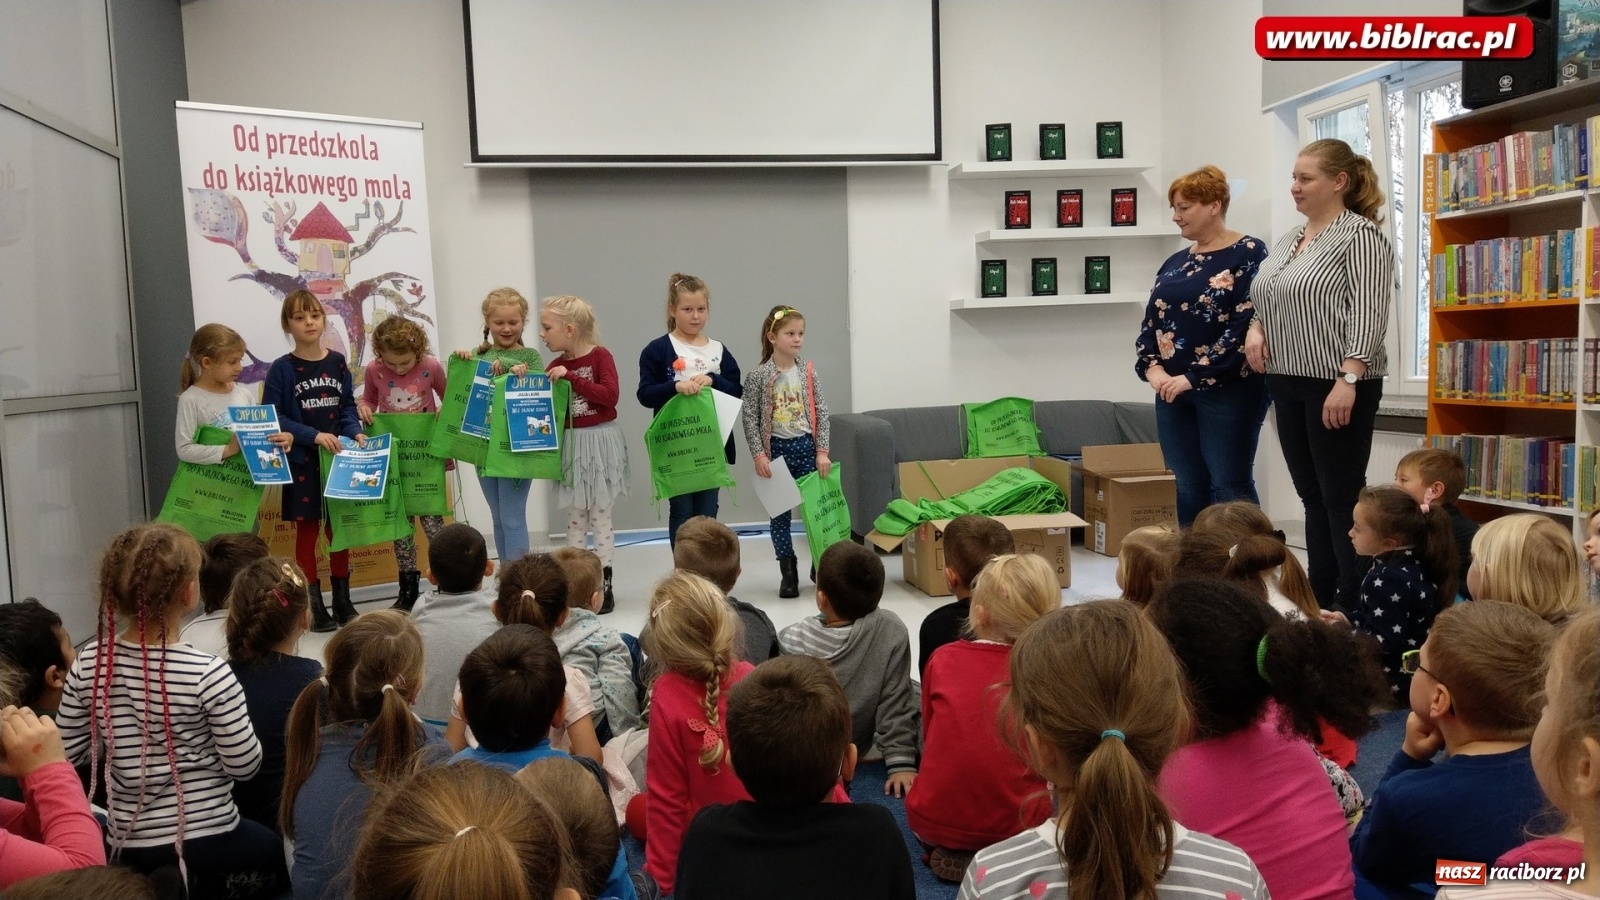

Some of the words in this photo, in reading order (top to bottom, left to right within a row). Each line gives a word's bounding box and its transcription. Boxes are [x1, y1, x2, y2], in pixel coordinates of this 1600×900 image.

[233, 123, 259, 152] Od
[266, 130, 379, 161] przedszkola
[202, 162, 228, 190] do
[235, 164, 358, 202] książkowego
[365, 174, 411, 200] mola
[1426, 159, 1434, 178] LAT
[1426, 182, 1434, 208] 12-14
